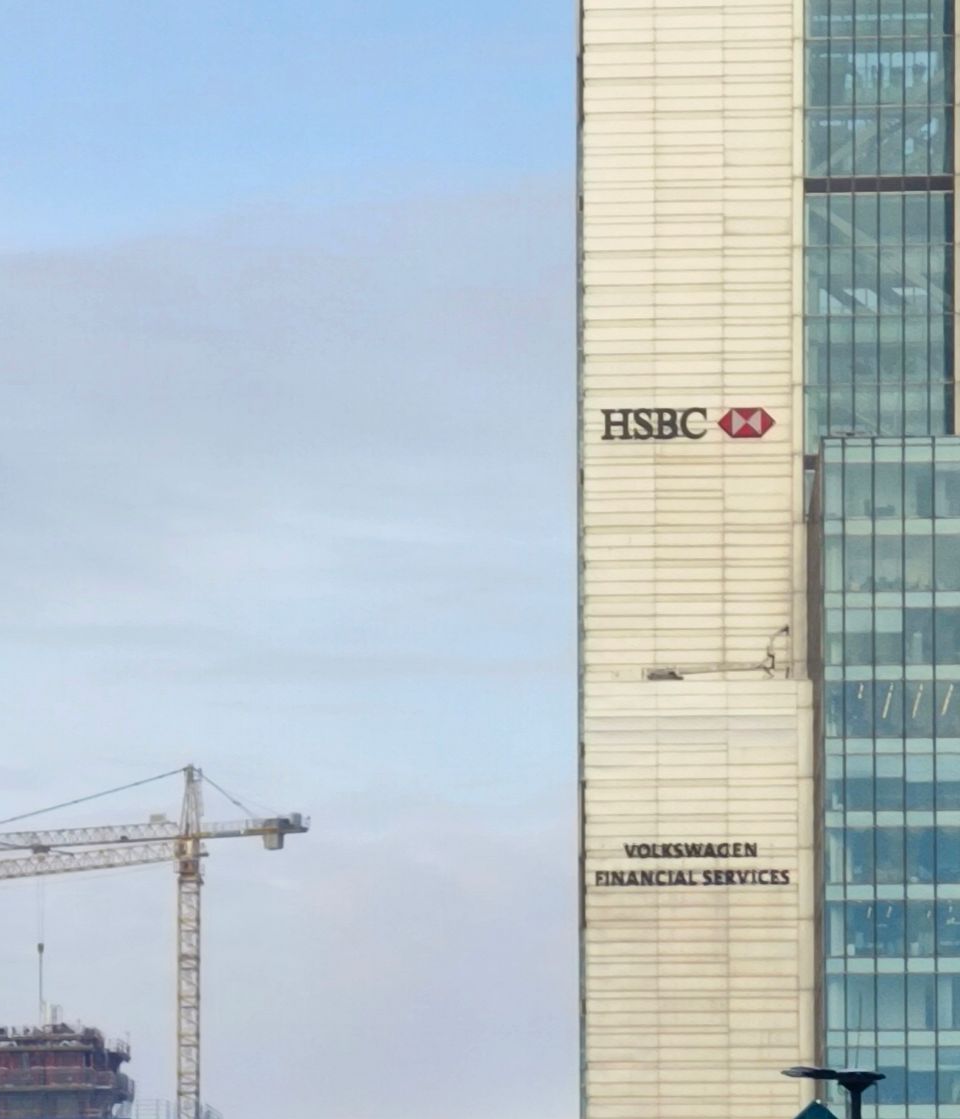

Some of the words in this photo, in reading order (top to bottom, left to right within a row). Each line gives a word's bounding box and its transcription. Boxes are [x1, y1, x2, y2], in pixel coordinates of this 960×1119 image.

[600, 407, 708, 440] HSBC
[624, 843, 758, 858] VOLKSWAGEN
[595, 870, 697, 886] FINANCIAL
[703, 869, 790, 885] SERVICES
